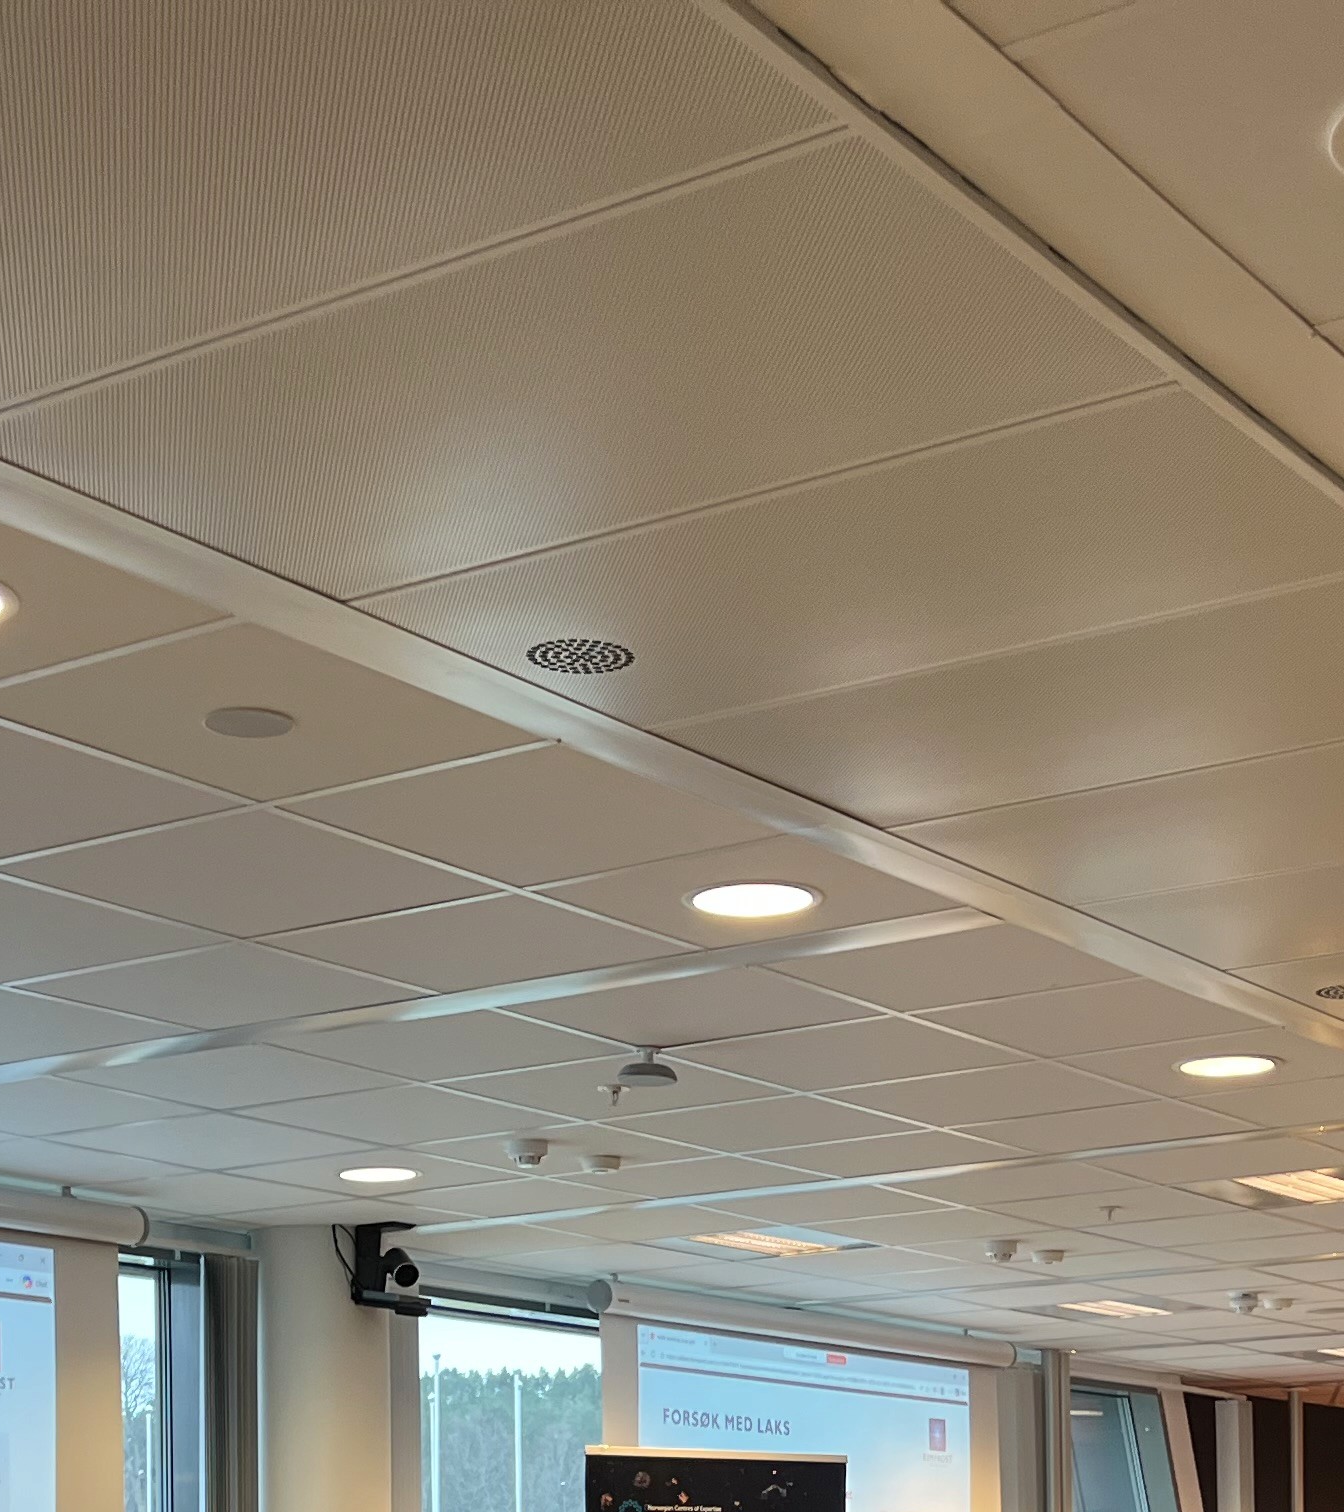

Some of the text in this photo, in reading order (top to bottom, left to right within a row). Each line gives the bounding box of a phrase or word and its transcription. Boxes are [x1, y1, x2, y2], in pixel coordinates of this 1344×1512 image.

[663, 1408, 791, 1436] FORSØK MED LAKS
